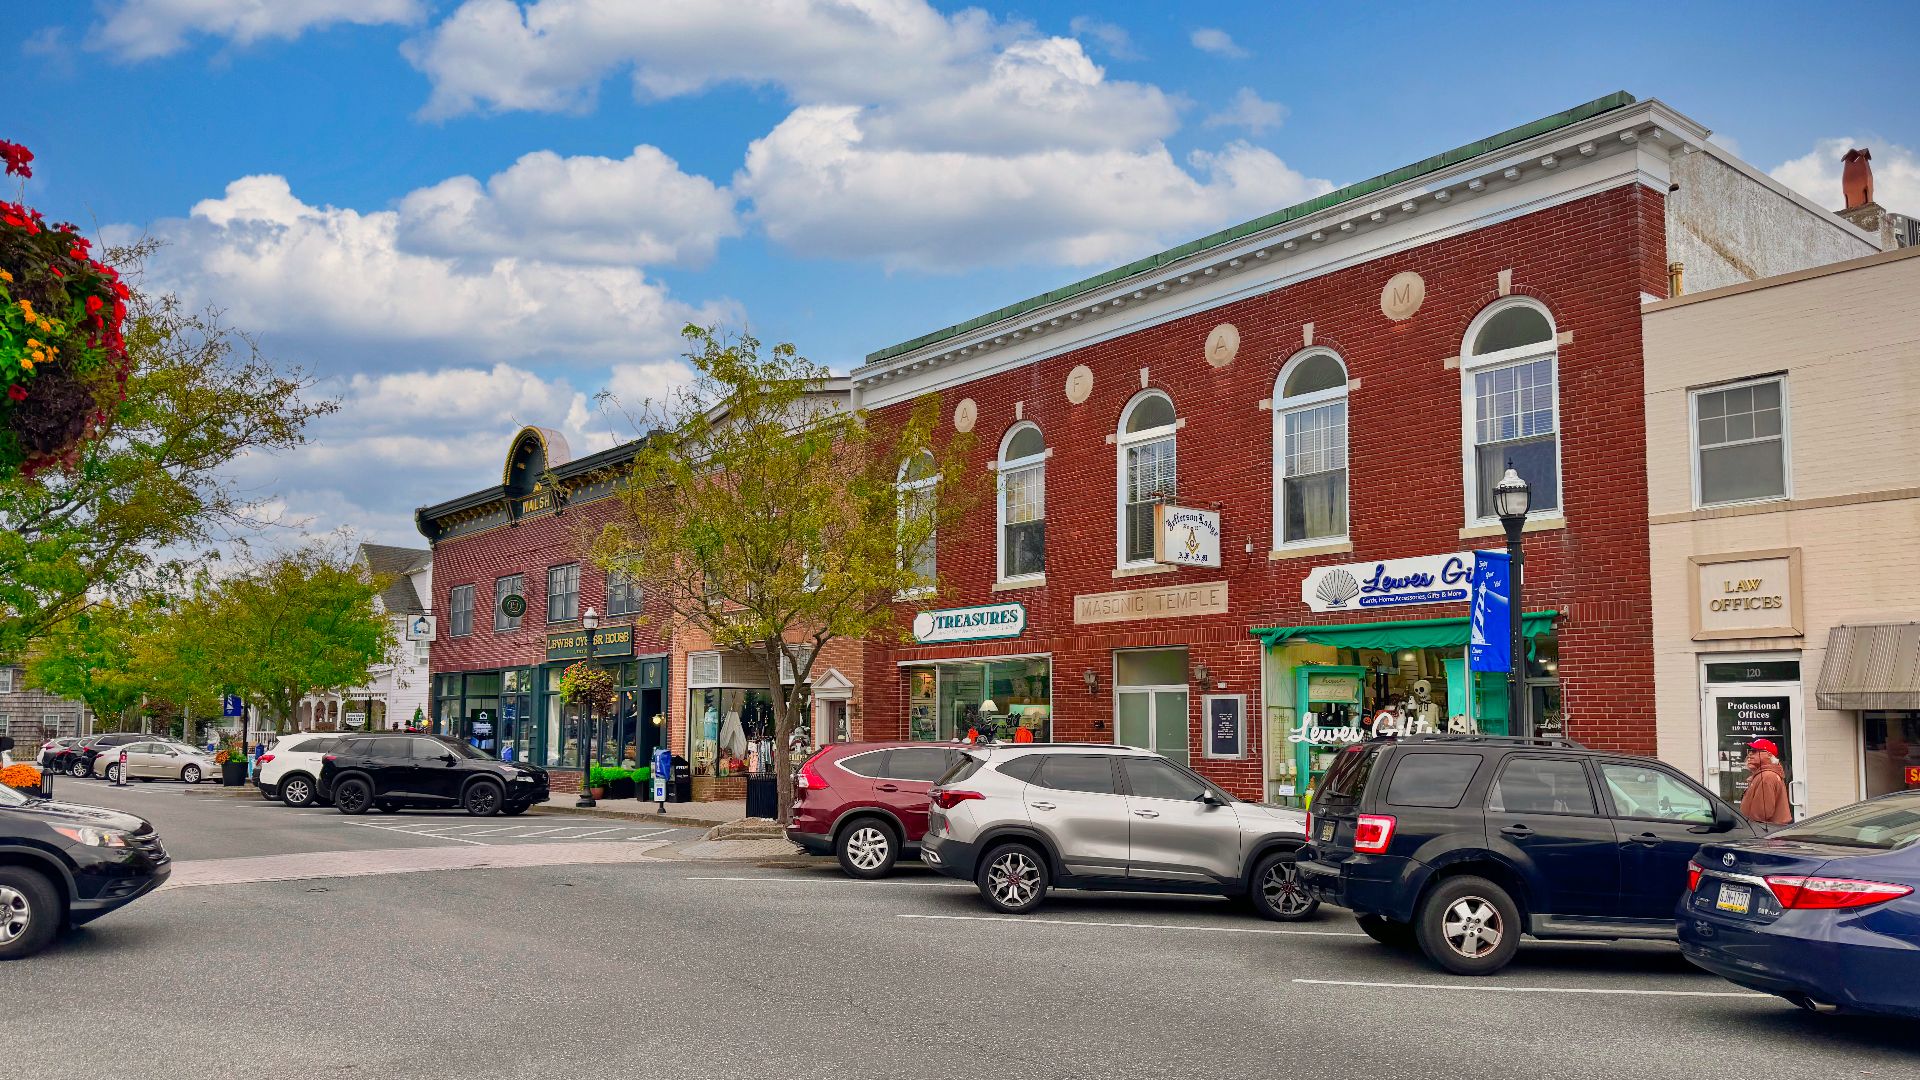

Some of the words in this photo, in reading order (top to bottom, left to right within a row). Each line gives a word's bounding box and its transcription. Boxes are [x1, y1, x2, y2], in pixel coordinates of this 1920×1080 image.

[960, 407, 970, 421] A
[1073, 375, 1083, 392] F
[1214, 335, 1228, 354] A
[1393, 283, 1411, 307] M
[523, 494, 550, 514] WALSH
[1166, 513, 1198, 531] Jefferson
[1198, 513, 1218, 536] Lodge
[1361, 563, 1434, 593] Lewes
[1441, 556, 1473, 585] Gi
[1724, 579, 1762, 593] LAW
[1082, 596, 1144, 617] MASONIC
[1156, 589, 1220, 611] TEMPLE
[1379, 595, 1395, 603] Home
[1427, 591, 1440, 599] Gifts
[1710, 596, 1782, 611] OFFICES
[936, 609, 1019, 629] TREASURES
[547, 637, 574, 650] LEWES
[575, 634, 604, 648] OYSER
[605, 631, 630, 645] HOUSE
[1746, 668, 1761, 678] 120
[1727, 701, 1780, 710] Professional
[1738, 710, 1770, 719] Offices
[1288, 712, 1364, 744] Lewes
